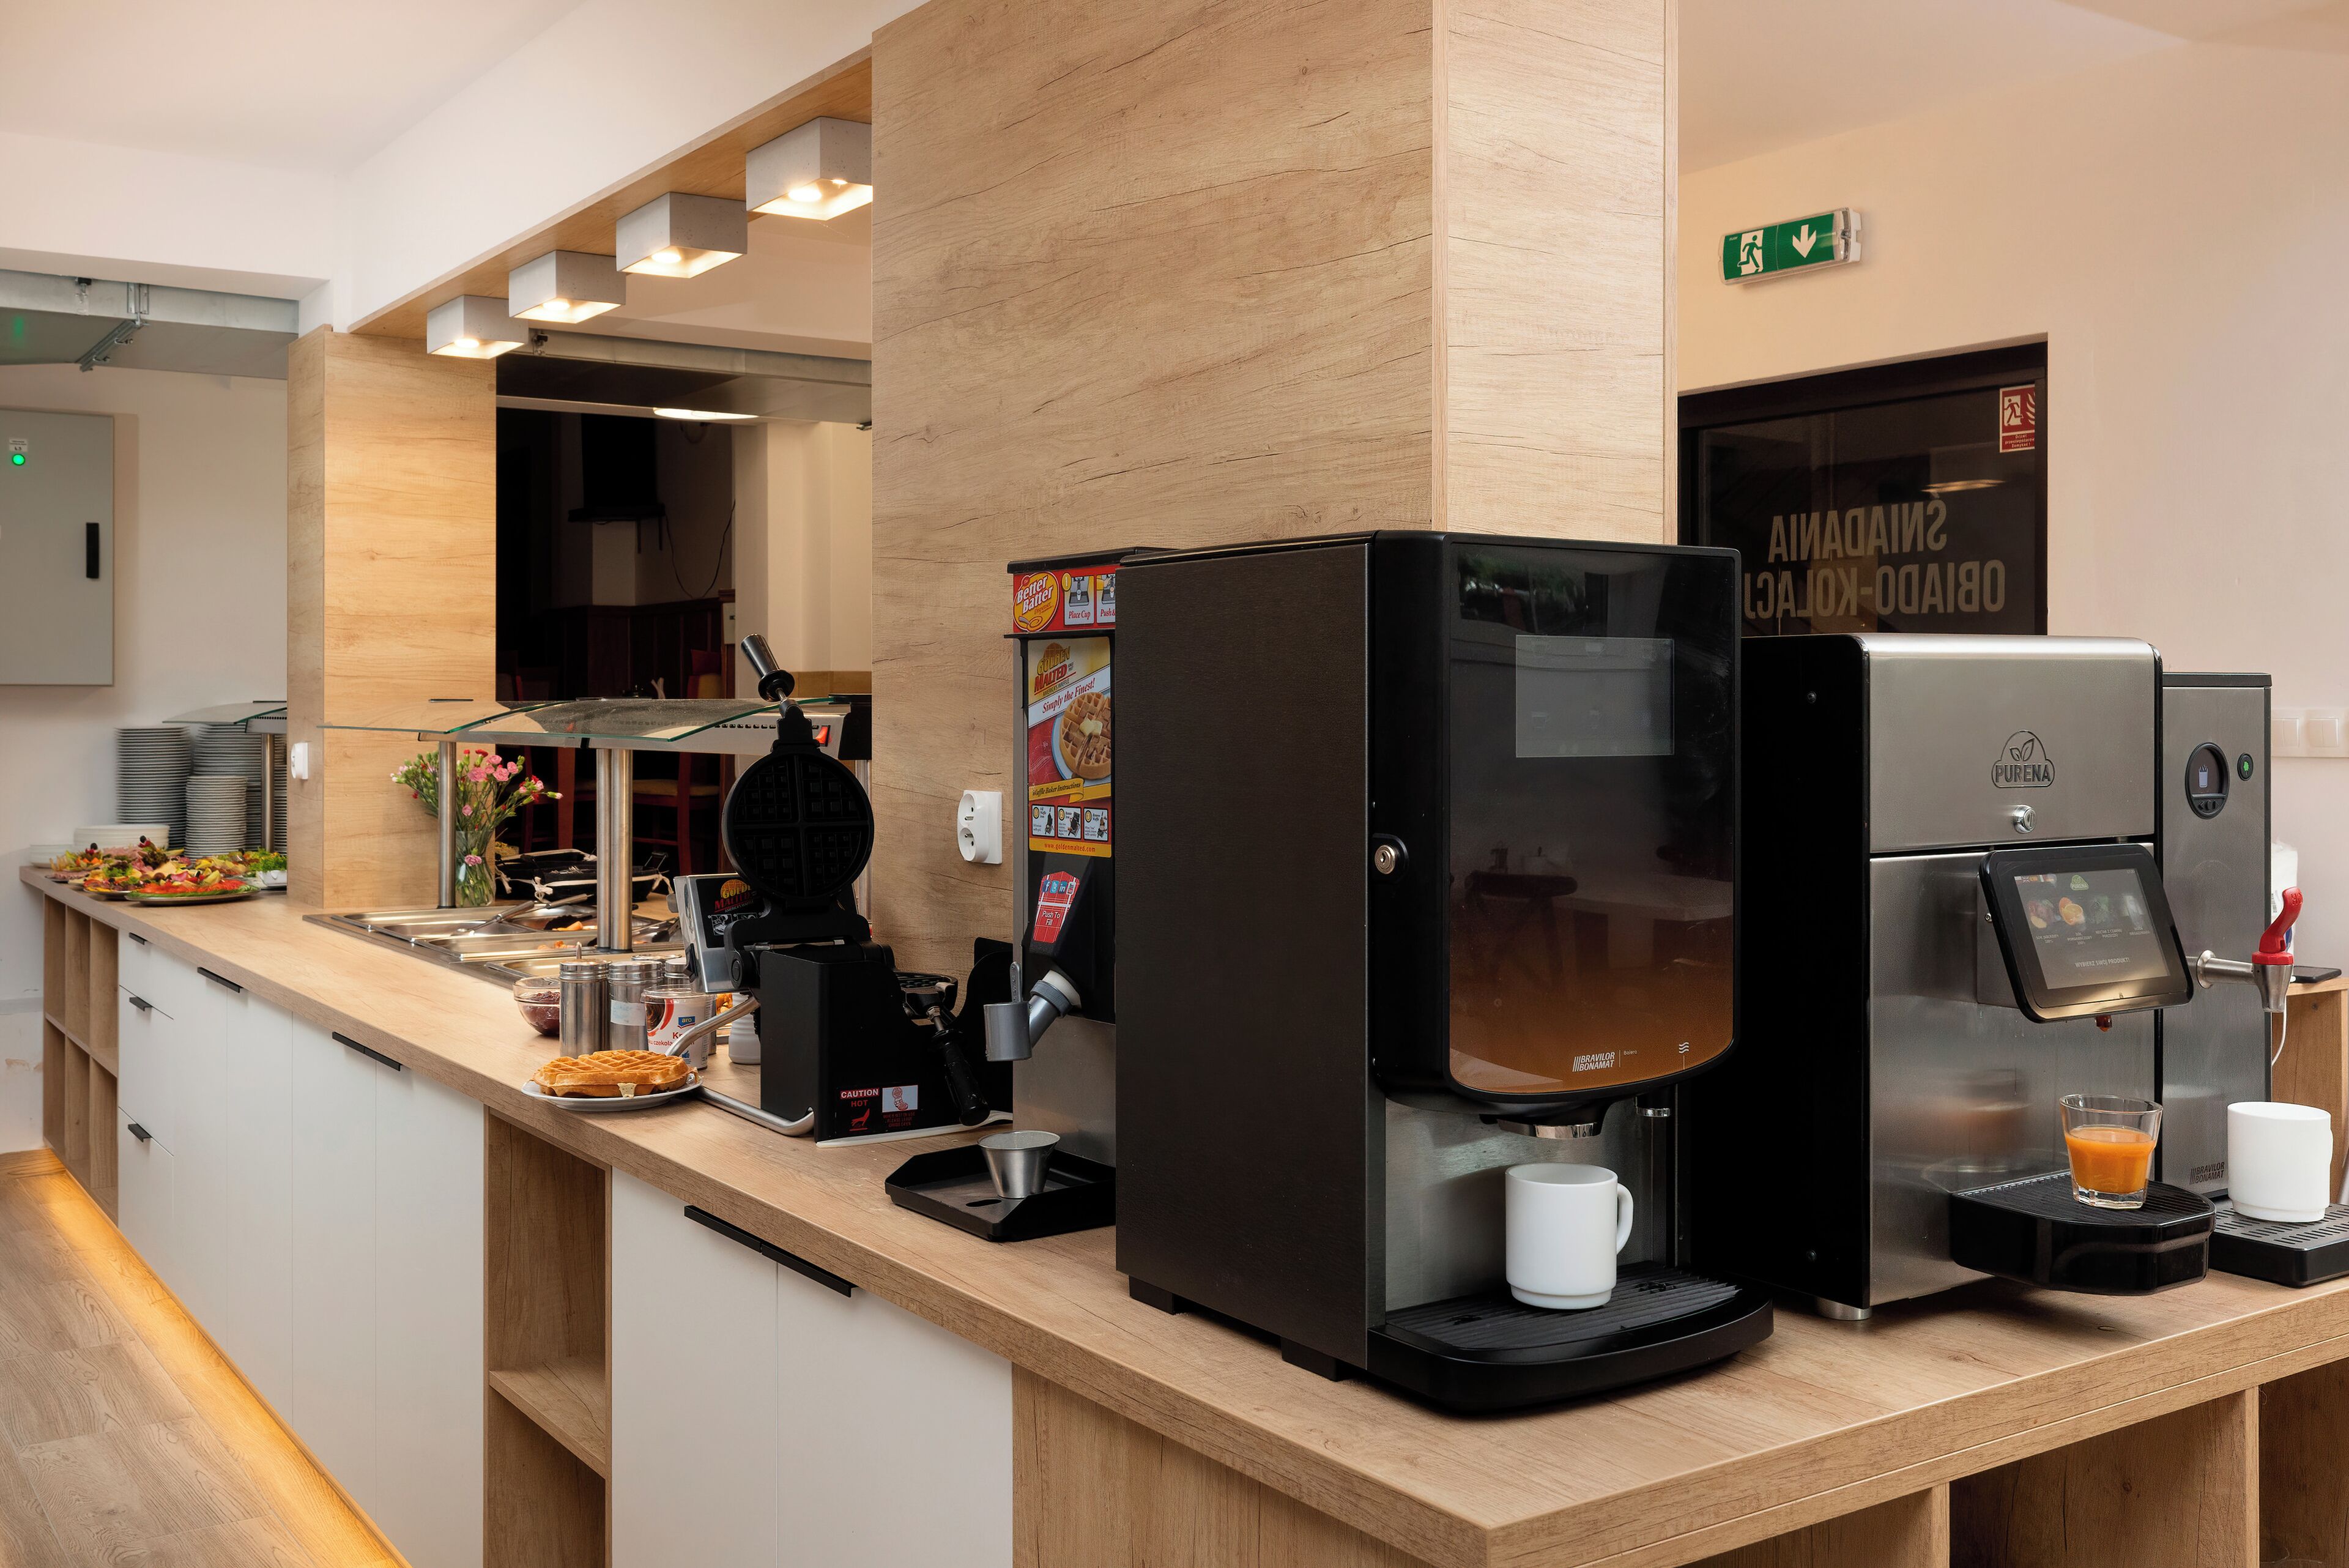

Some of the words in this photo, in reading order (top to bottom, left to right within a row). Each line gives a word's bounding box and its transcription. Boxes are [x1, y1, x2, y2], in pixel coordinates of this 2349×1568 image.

[1016, 575, 1048, 604] Better
[1022, 585, 1053, 614] Batter
[1069, 611, 1080, 619] Place
[1082, 610, 1091, 620] Cup
[1100, 608, 1111, 617] Push
[1037, 646, 1071, 675] GOLDEN
[1034, 664, 1067, 693] MALTED
[1042, 696, 1063, 713] Simply
[1064, 691, 1074, 702] the
[1074, 677, 1096, 697] Finest!
[1995, 764, 2050, 782] PURENA
[1057, 782, 1081, 792] Instructions
[1044, 844, 1096, 852] www.goldenmalted.com
[1580, 1052, 1615, 1063] BRAVILOR
[1579, 1060, 1614, 1071] BONAMAT
[841, 1089, 878, 1098] CAUTION
[2196, 1162, 2224, 1175] BRAVILOR
[2195, 1170, 2224, 1184] BONAMAT
